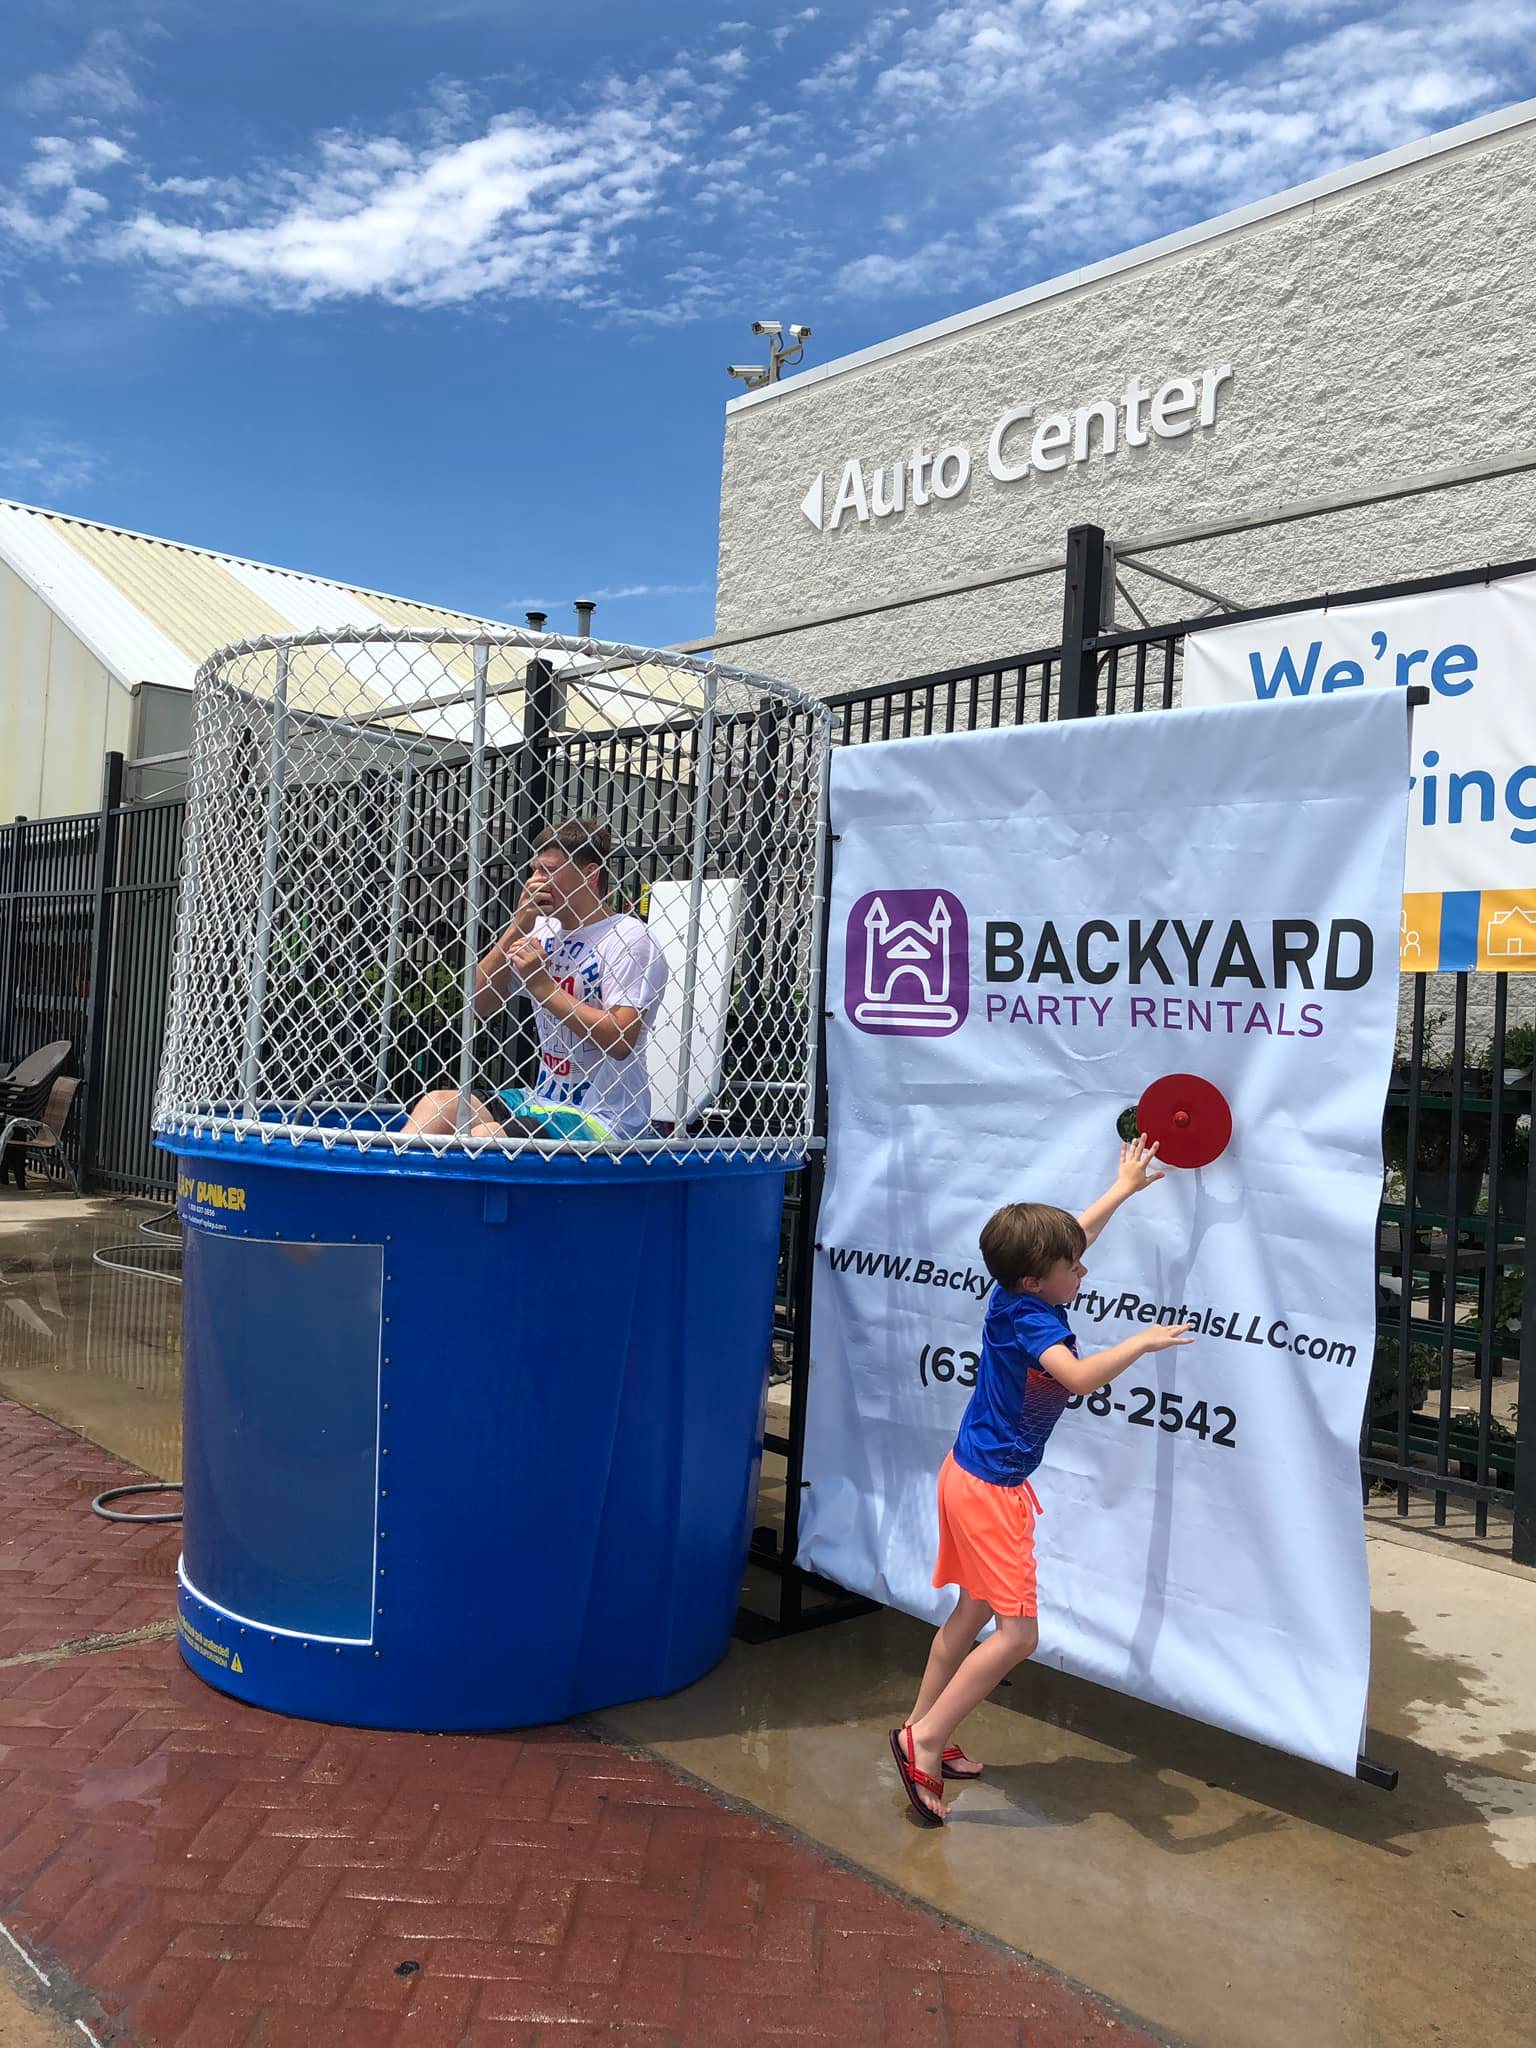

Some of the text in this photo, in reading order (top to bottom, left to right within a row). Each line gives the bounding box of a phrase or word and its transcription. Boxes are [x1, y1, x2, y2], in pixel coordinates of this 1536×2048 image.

[830, 363, 1234, 529] Auto Center
[984, 918, 1375, 992] BACKYARD
[986, 994, 1325, 1039] PARTY RENTALS
[196, 1181, 247, 1213] DUNKER
